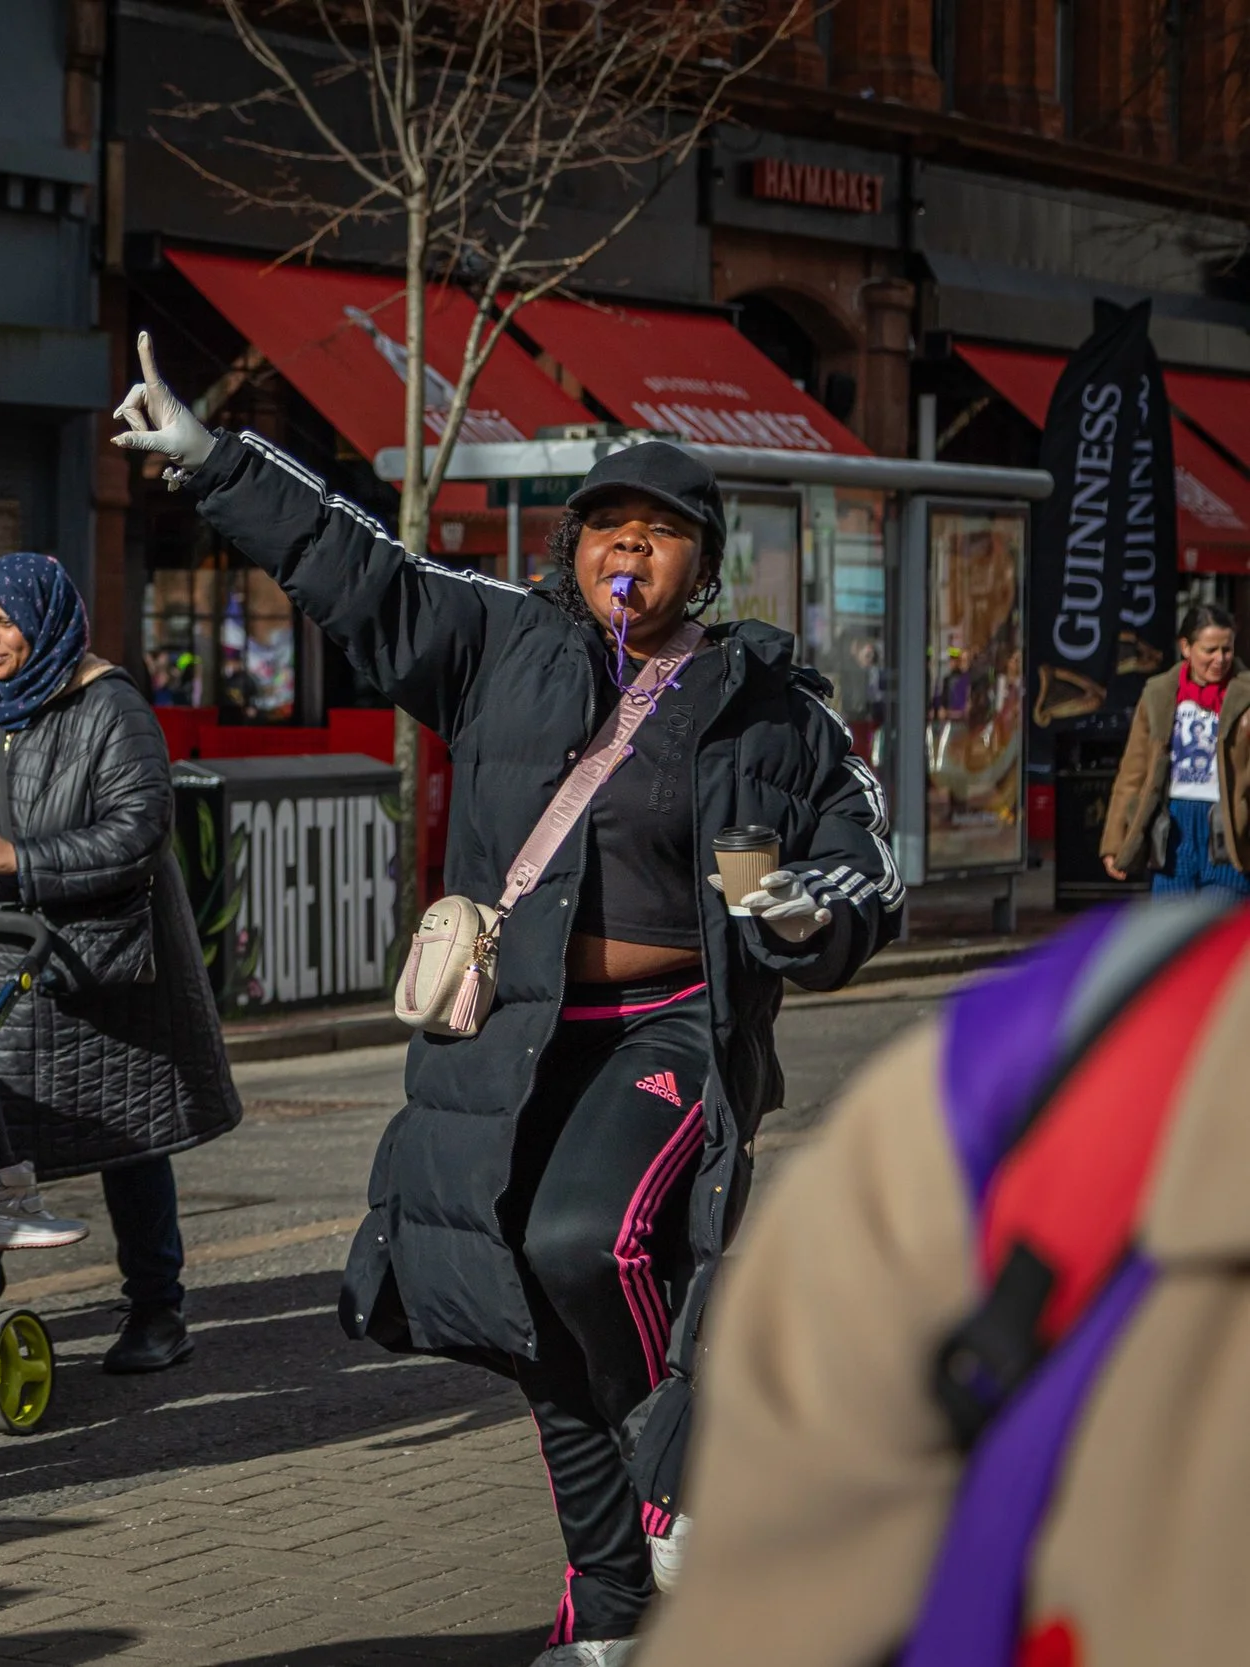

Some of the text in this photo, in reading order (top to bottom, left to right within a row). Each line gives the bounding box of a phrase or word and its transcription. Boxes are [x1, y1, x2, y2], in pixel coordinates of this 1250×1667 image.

[764, 157, 885, 215] HAYMARKET
[1052, 381, 1121, 661] GUINNESS
[230, 792, 398, 1005] TOGETHER
[635, 1080, 682, 1107] adidas
